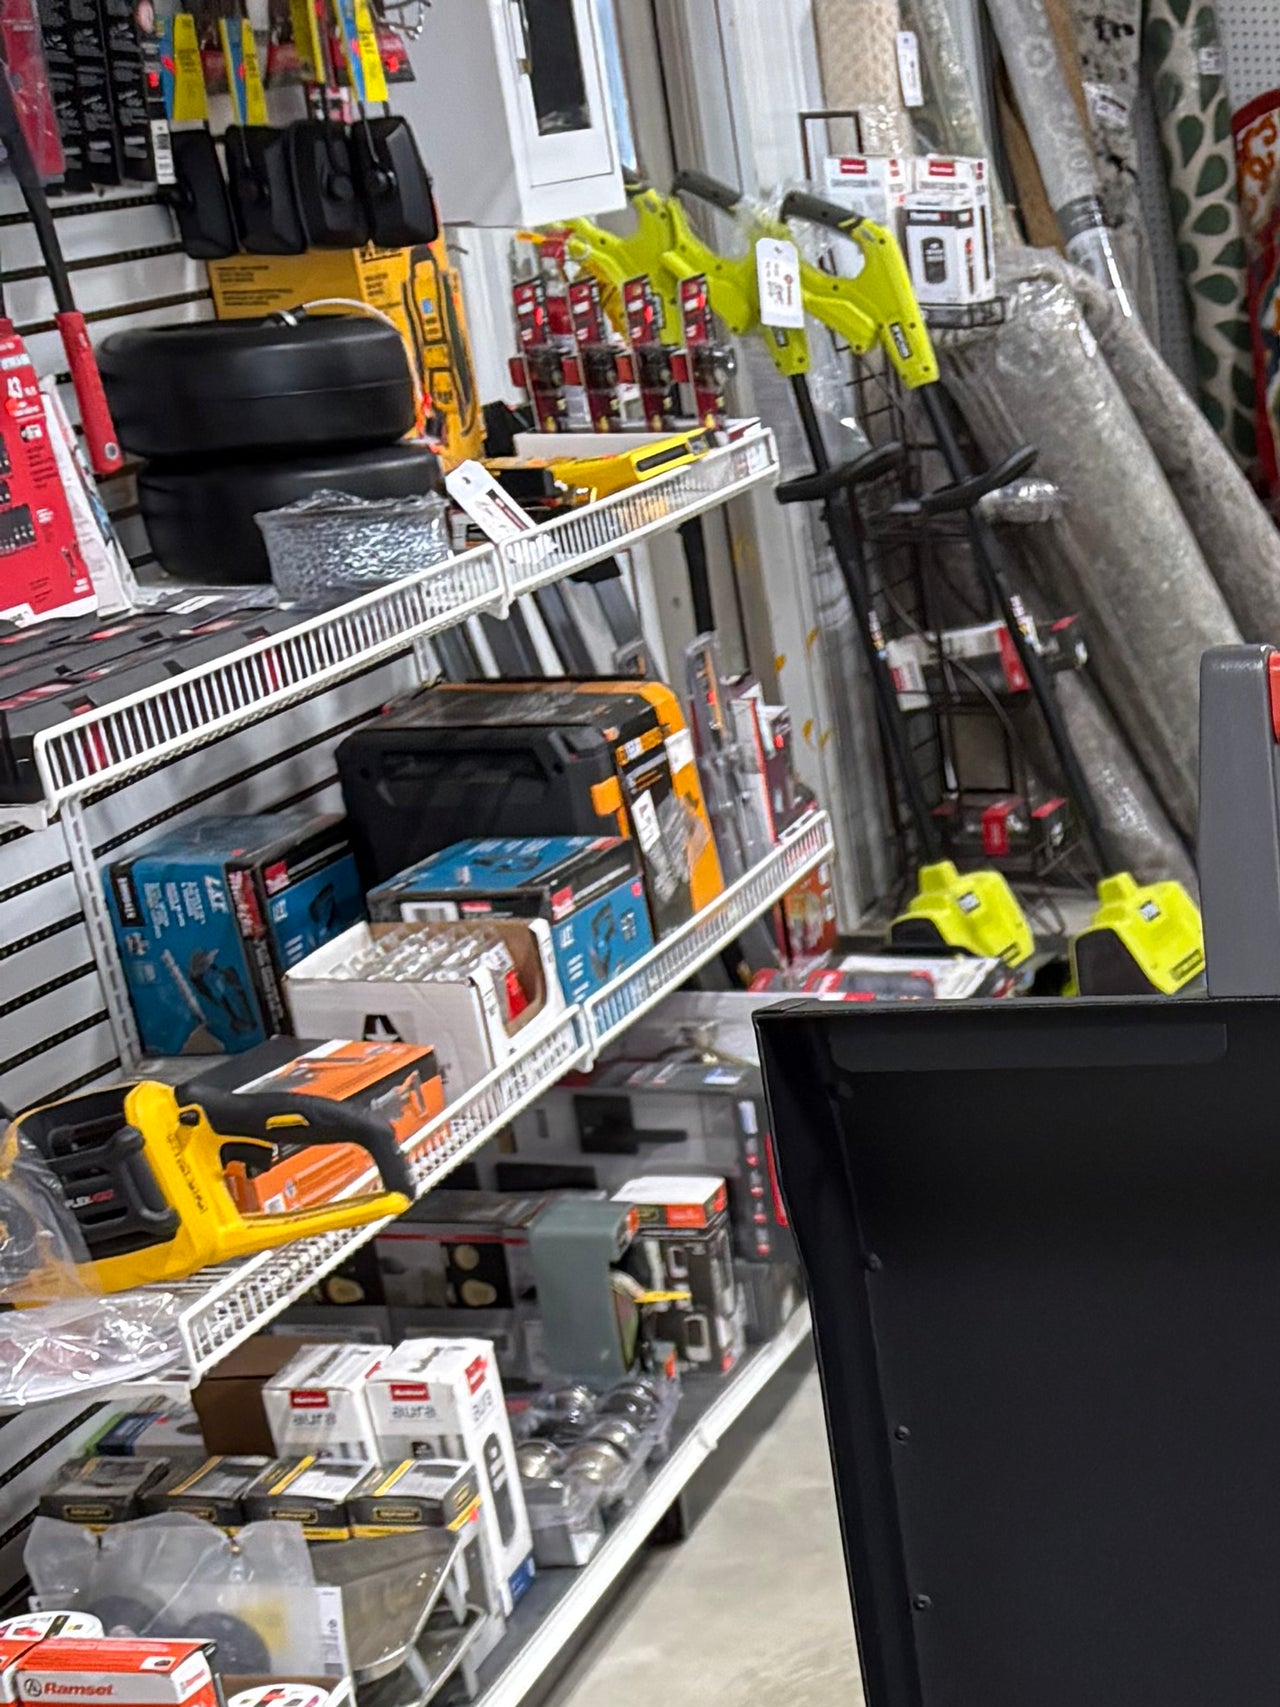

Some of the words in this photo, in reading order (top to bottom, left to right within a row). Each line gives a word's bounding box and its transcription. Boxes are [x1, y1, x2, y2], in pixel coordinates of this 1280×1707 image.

[392, 1405, 436, 1418] aura
[292, 1413, 336, 1426] aura
[43, 1682, 113, 1695] Ramset
